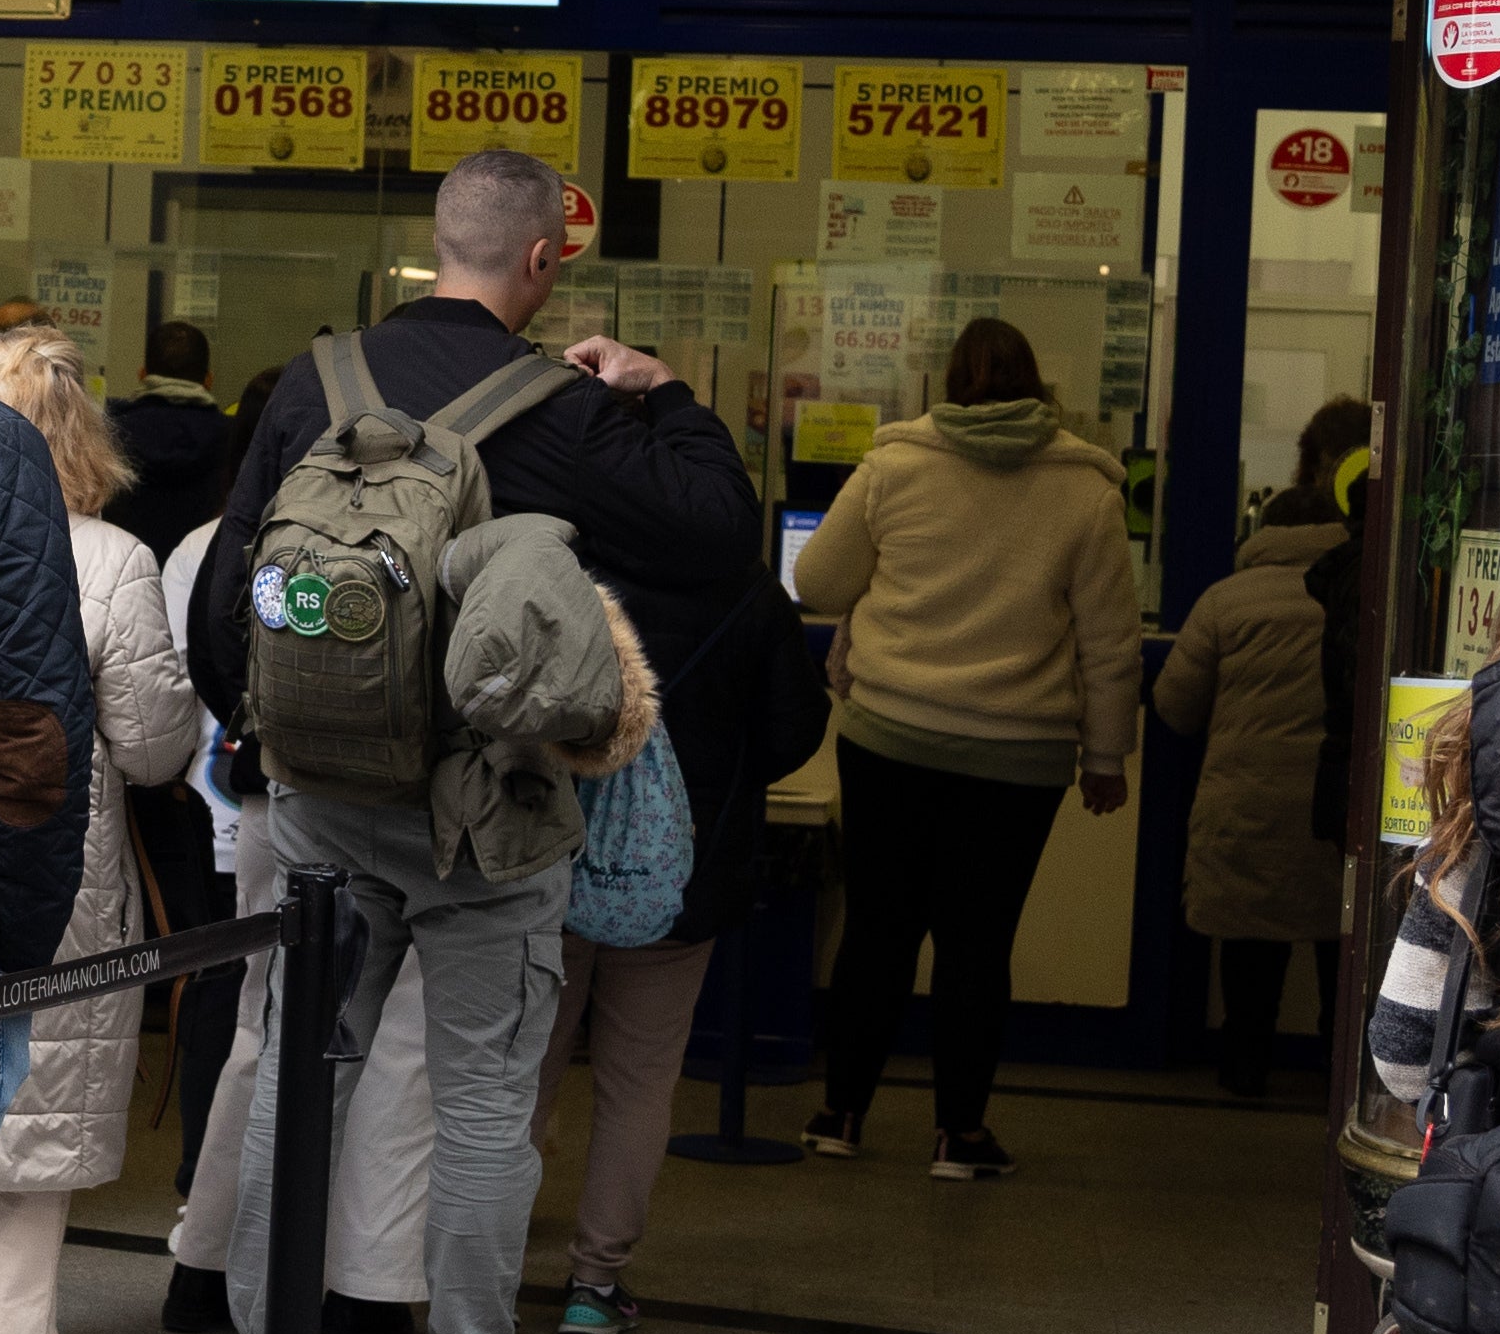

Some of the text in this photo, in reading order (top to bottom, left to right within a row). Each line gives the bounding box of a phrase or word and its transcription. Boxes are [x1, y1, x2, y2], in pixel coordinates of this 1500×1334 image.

[40, 60, 171, 87] 57033
[246, 65, 344, 85] PREMIO
[456, 70, 556, 91] PREMIO
[678, 75, 779, 97] PREMIO
[63, 88, 167, 113] PREMIO
[215, 84, 353, 118] 01568
[880, 83, 984, 104] PREMIO
[427, 89, 567, 124] 88008
[645, 95, 789, 131] 88979
[848, 103, 988, 138] 57421
[1287, 135, 1334, 164] +18
[834, 330, 901, 351] 66.962
[295, 591, 321, 610] RS
